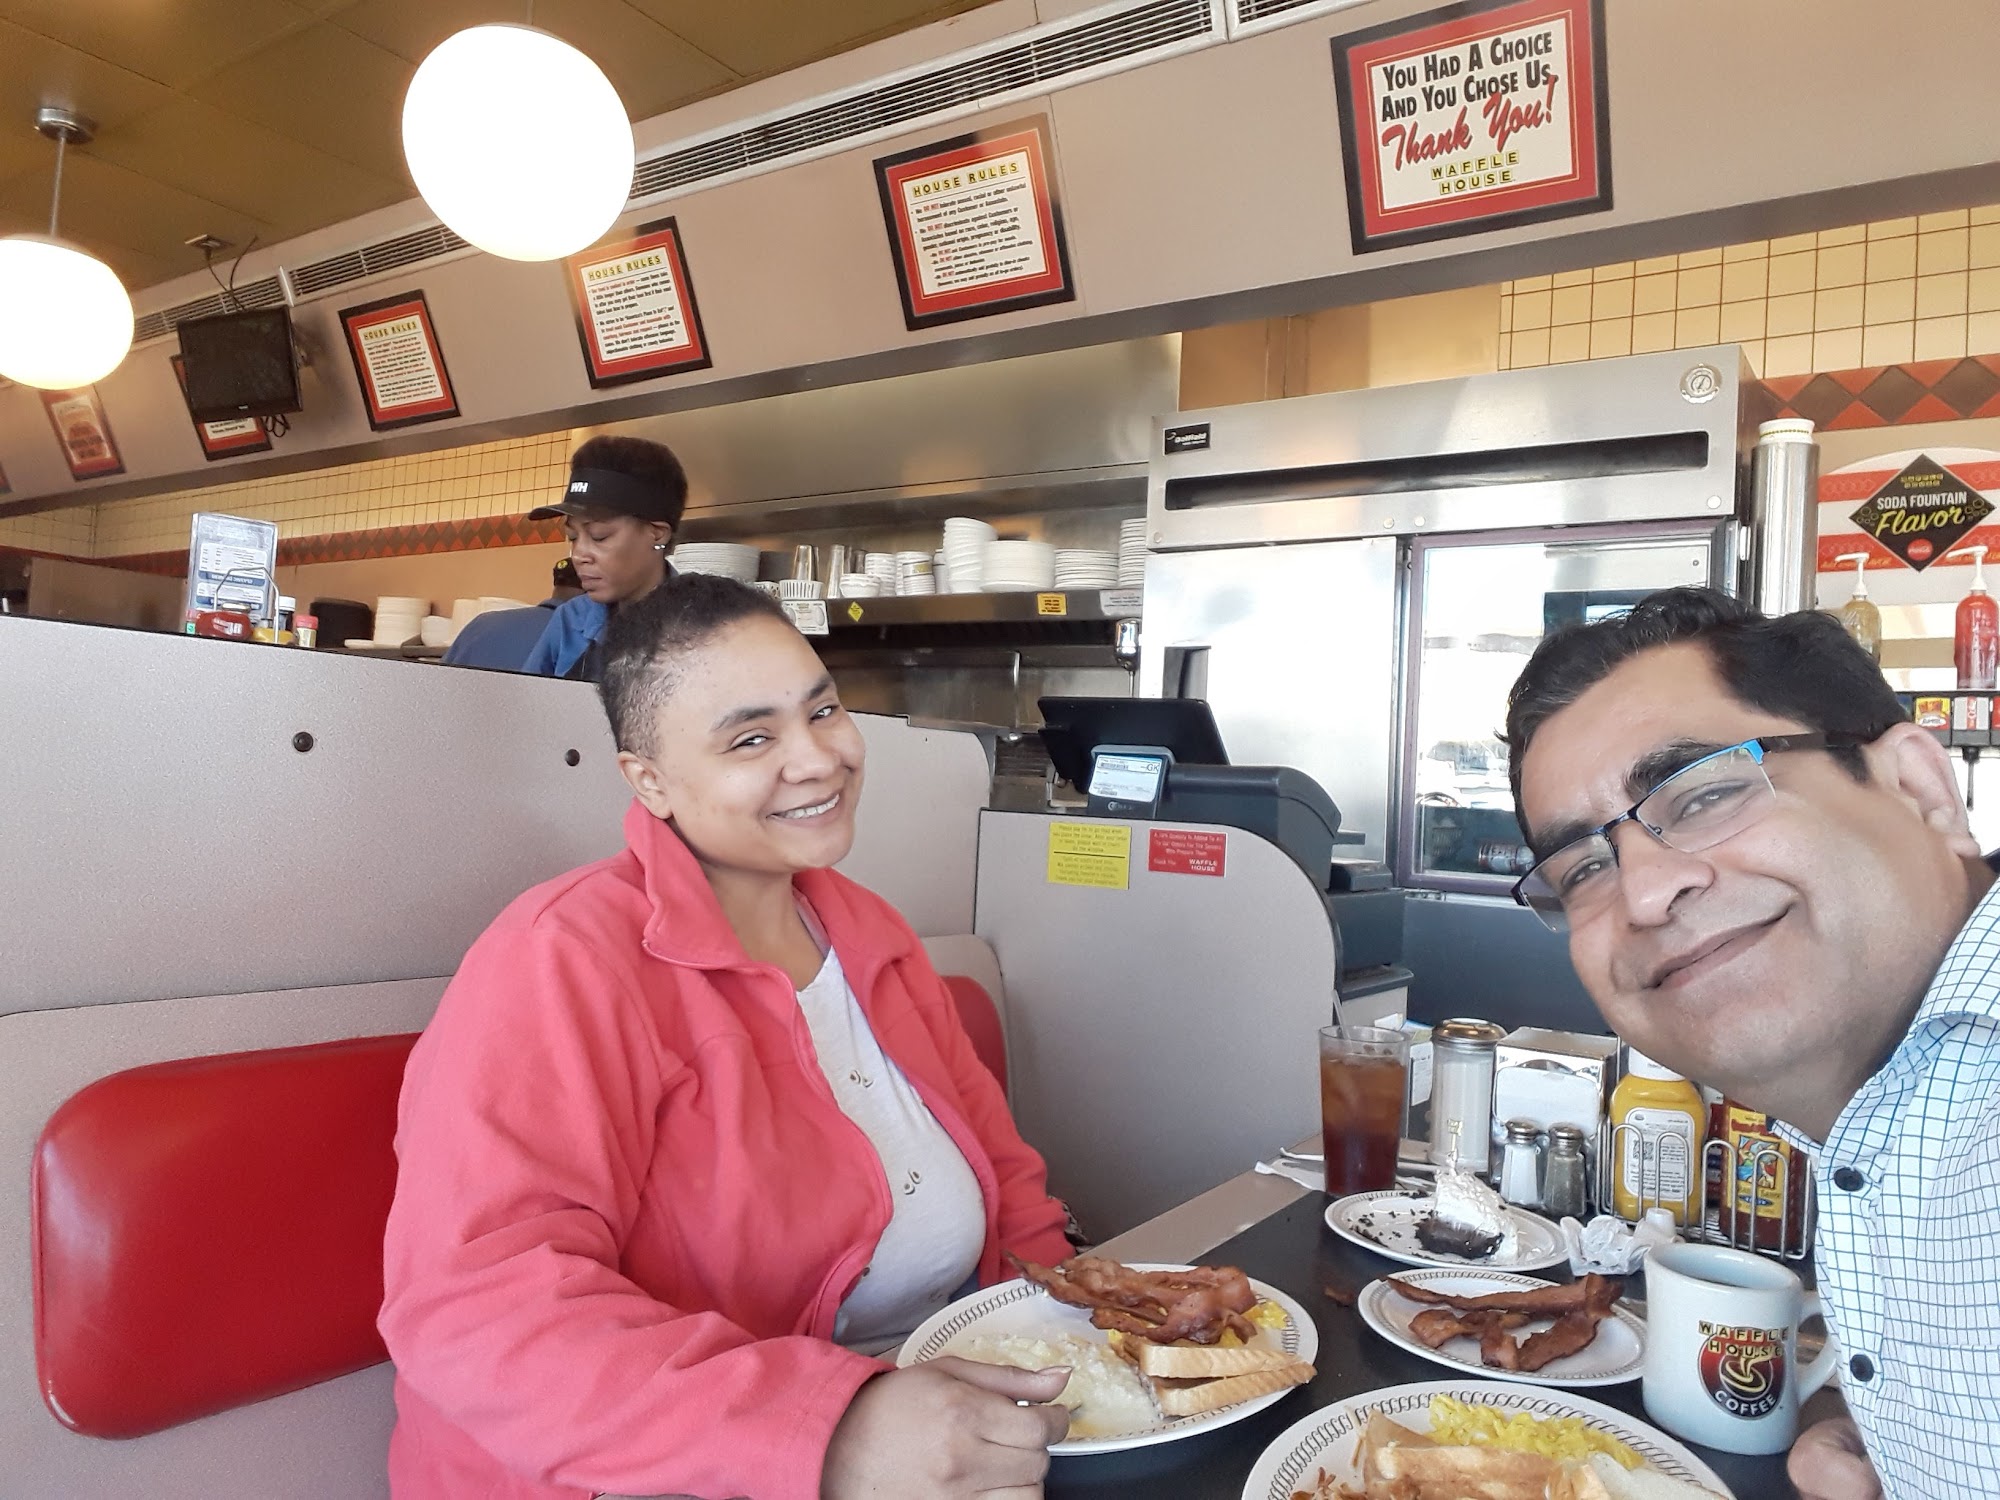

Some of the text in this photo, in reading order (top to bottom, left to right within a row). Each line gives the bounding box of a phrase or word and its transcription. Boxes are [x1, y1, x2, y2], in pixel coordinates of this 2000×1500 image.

[1383, 32, 1552, 91] YOU HAD A CHOICE
[1382, 95, 1416, 122] AND
[1422, 85, 1456, 112] YOU
[1464, 72, 1518, 103] CHOSE
[1382, 74, 1559, 171] Thank You!
[1432, 151, 1519, 179] WAFFLE
[913, 163, 1018, 196] HOUSE RULES
[1440, 170, 1513, 194] HOUSE
[588, 255, 661, 280] HOUSE RULES
[364, 322, 417, 340] HOUSE RULES
[570, 482, 588, 492] WH
[1876, 492, 1967, 510] SODA FOUNTAIN
[1875, 505, 1966, 538] Flavor
[1189, 858, 1218, 867] WAFFLE
[1191, 864, 1216, 872] HOUSE
[1699, 1321, 1789, 1340] WAFFLE
[1709, 1341, 1783, 1357] HOUSE
[1715, 1390, 1777, 1415] COFFEE
